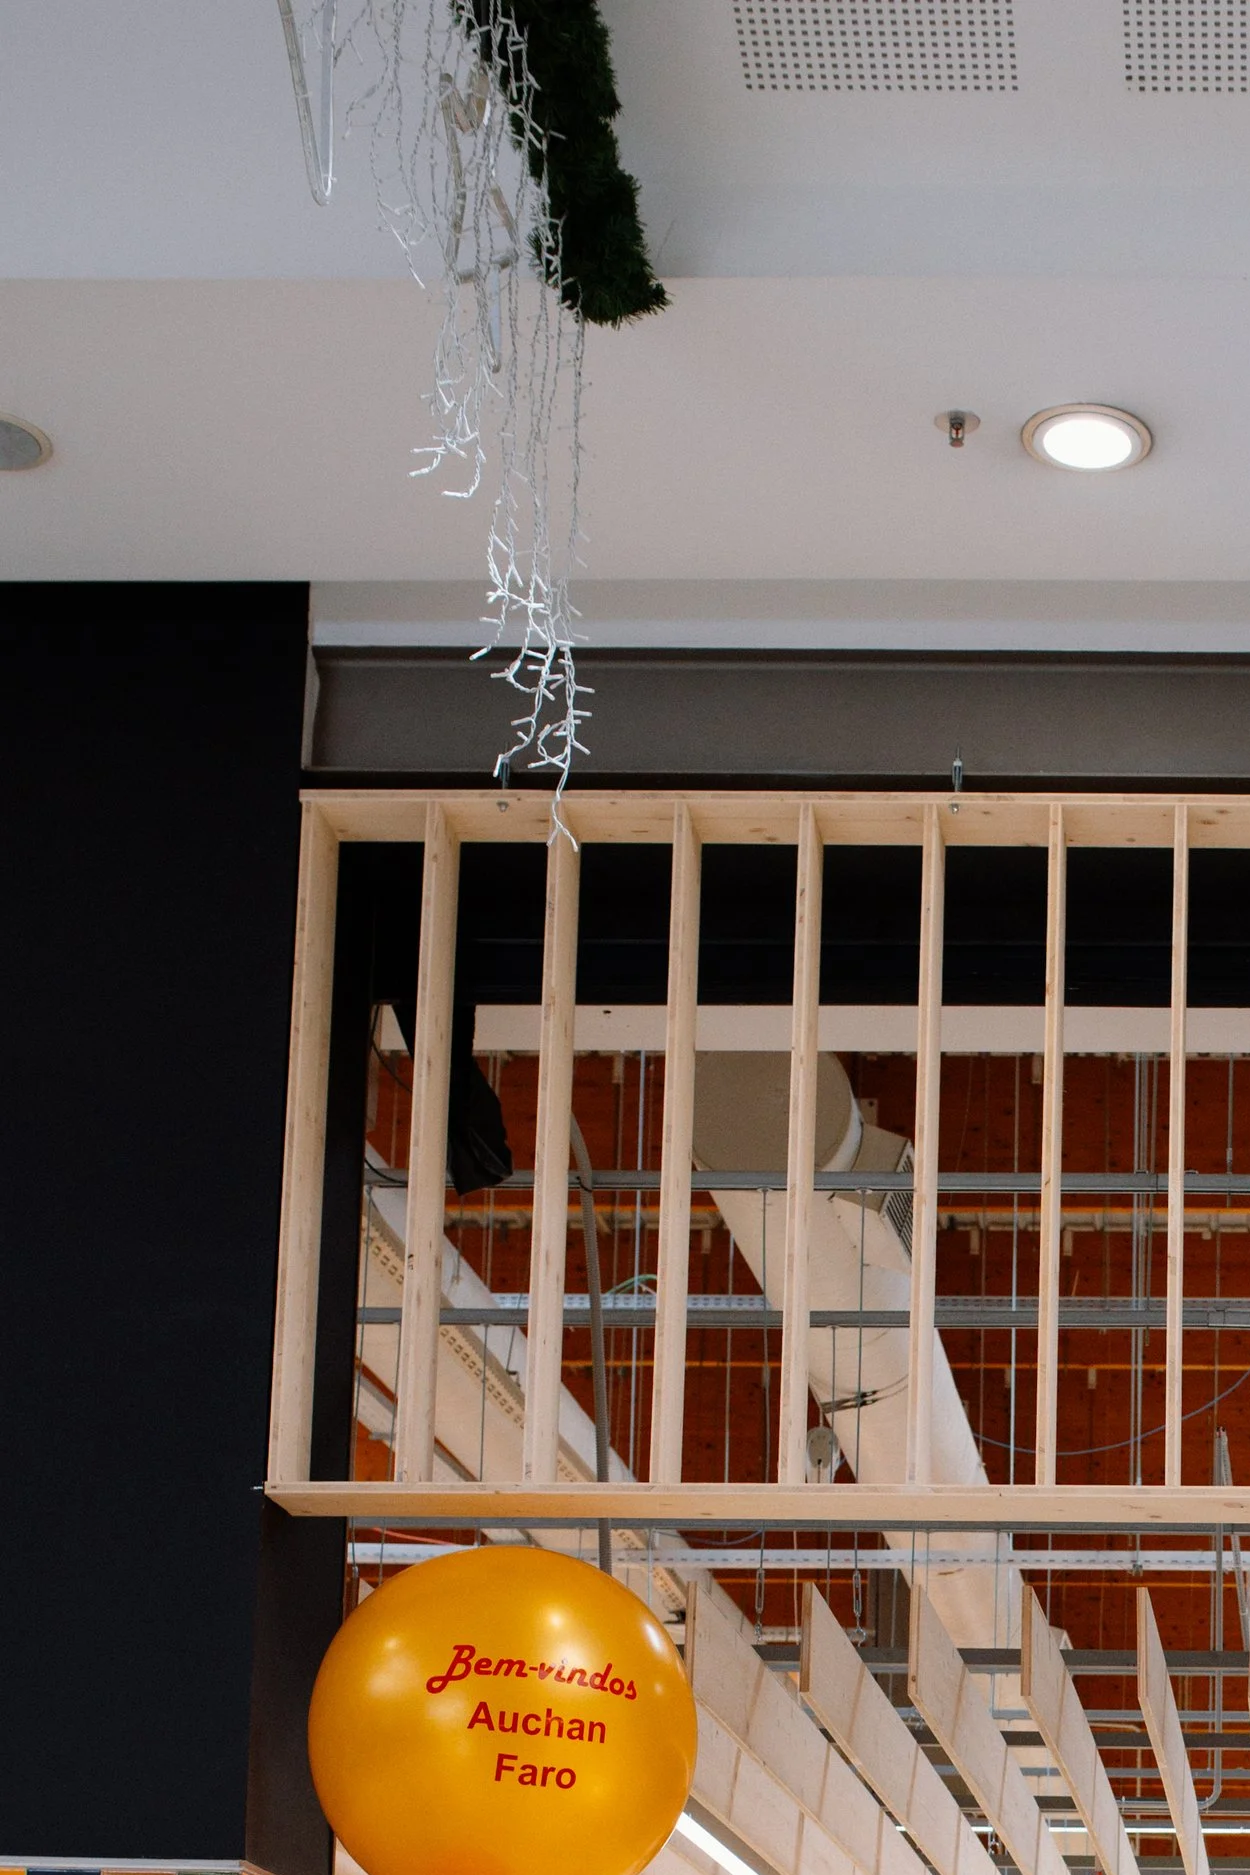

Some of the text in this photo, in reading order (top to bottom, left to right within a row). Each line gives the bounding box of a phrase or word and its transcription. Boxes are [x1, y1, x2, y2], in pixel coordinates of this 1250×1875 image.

[426, 1644, 637, 1700] Bem-vindos
[467, 1701, 606, 1743] Auchan
[494, 1753, 577, 1790] Faro
